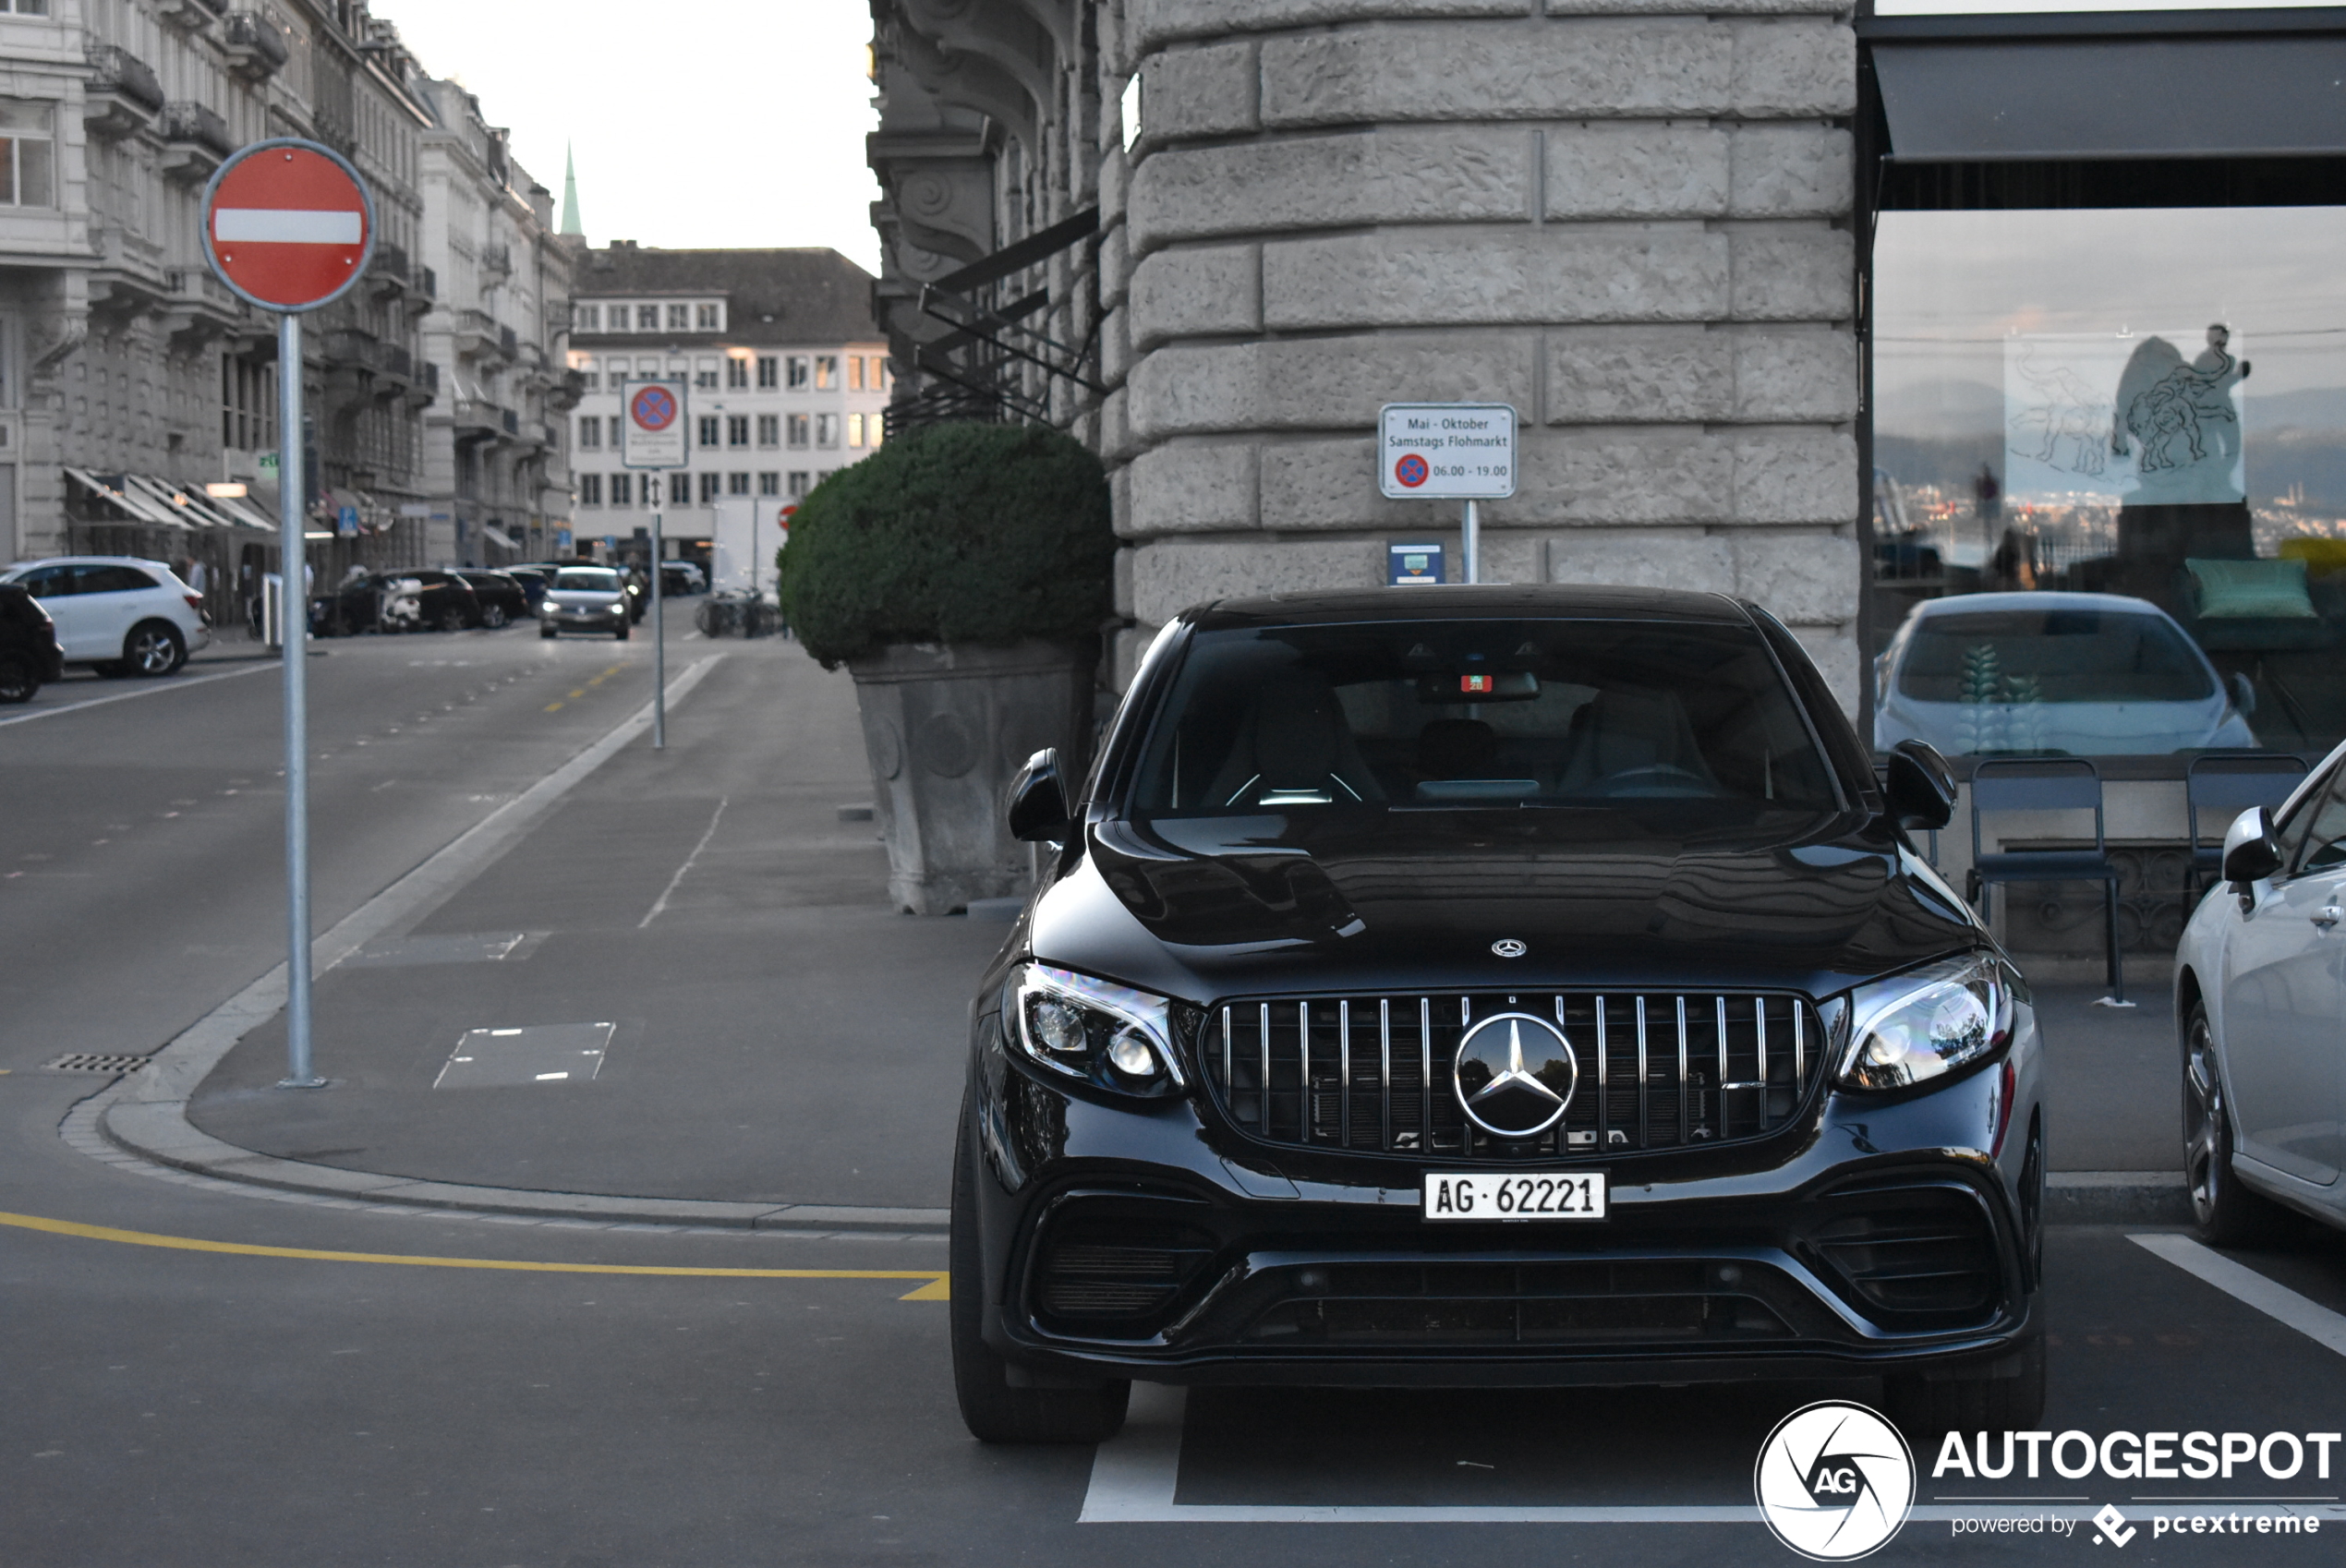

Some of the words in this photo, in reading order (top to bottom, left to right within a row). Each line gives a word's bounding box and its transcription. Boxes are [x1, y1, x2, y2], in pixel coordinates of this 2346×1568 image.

[1408, 418, 1430, 430] Mai
[1442, 418, 1489, 430] Oktober
[1389, 436, 1445, 450] Samstags
[1448, 436, 1507, 447] Flohmarkt
[1433, 465, 1465, 476] 06.00
[1477, 465, 1507, 476] 19.00
